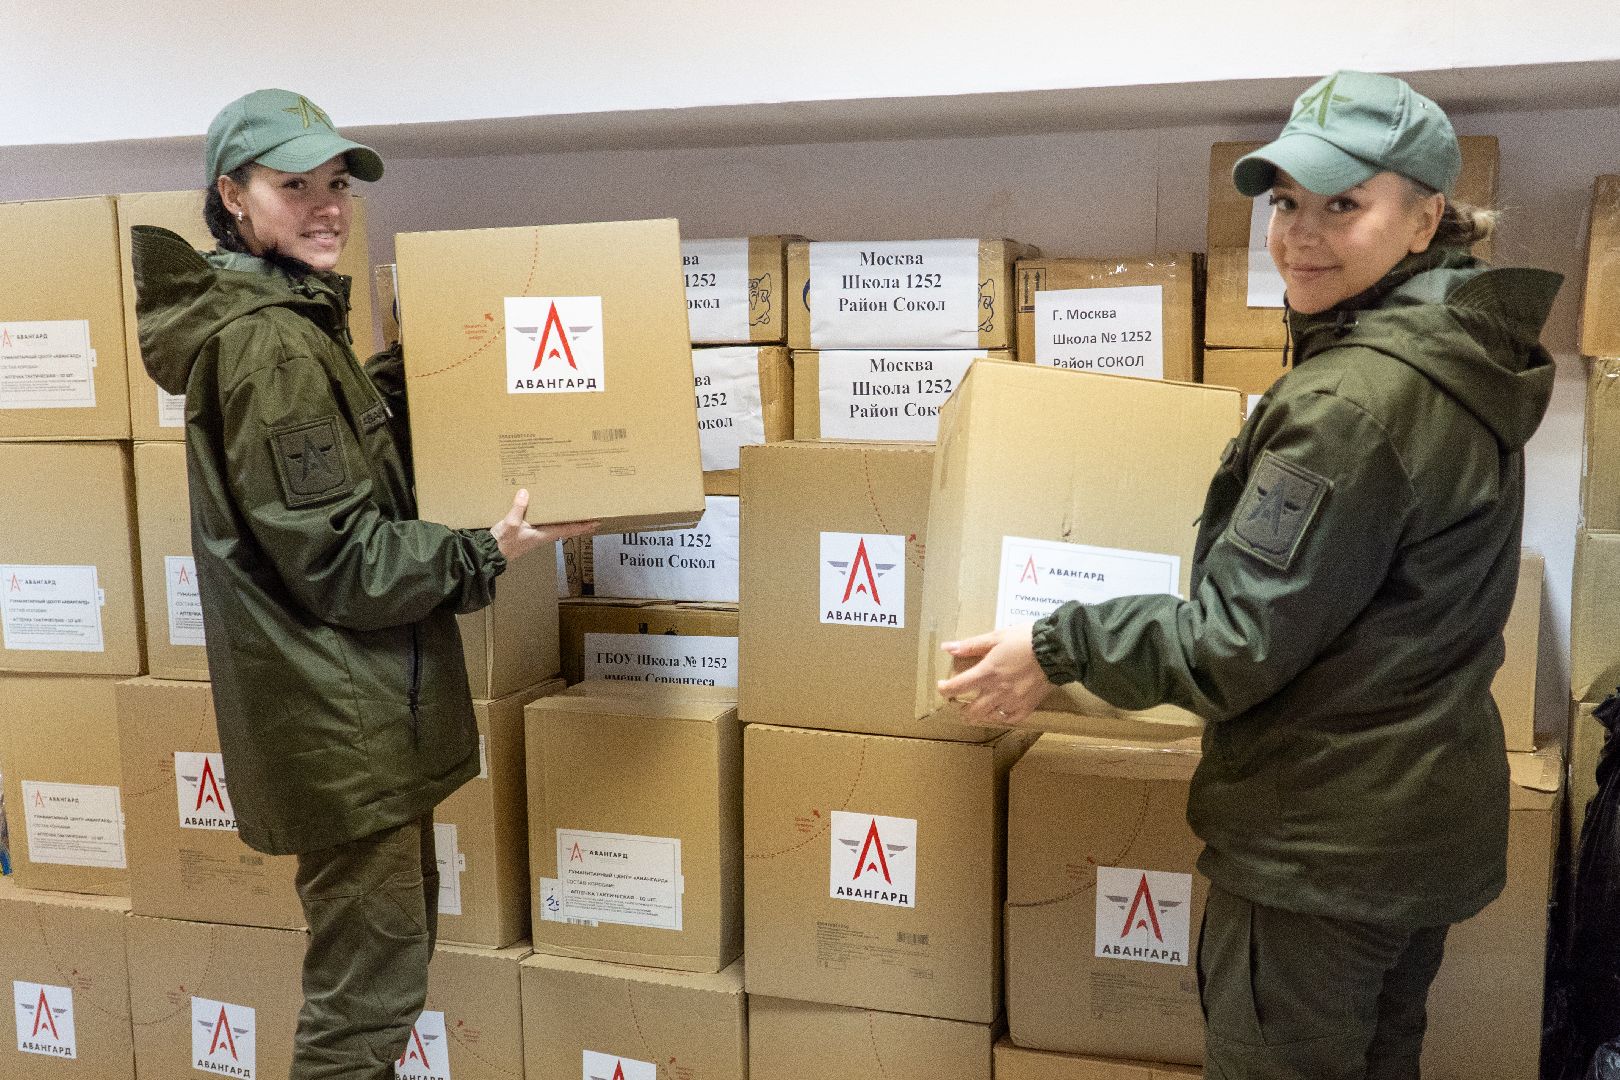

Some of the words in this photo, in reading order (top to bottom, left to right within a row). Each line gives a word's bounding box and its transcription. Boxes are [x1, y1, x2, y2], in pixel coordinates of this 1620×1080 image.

[860, 251, 923, 266] Москва
[685, 273, 716, 287] 1252
[841, 274, 900, 289] Школа
[906, 273, 942, 288] 1252
[687, 298, 720, 309] окол
[839, 296, 887, 312] Район
[893, 296, 946, 311] Сокол
[1052, 309, 1062, 320] Г.
[1066, 309, 1117, 320] Москва
[1053, 333, 1097, 345] Школа
[1101, 332, 1117, 343] №
[1121, 330, 1152, 342] 1252
[869, 357, 933, 373] Москва
[1053, 357, 1093, 368] Район
[1097, 355, 1144, 368] СОКОЛ
[515, 378, 597, 390] АВАНГАРД
[852, 380, 910, 396] Школа
[917, 378, 952, 394] 1252
[696, 392, 727, 409] 1252
[849, 402, 898, 419] Район
[904, 402, 940, 417] Сок
[698, 417, 733, 431] окол
[622, 533, 674, 547] Школа
[679, 533, 712, 548] 1252
[619, 552, 663, 568] Район
[668, 554, 715, 569] Сокол
[1049, 567, 1105, 582] АВАНГАРД
[1015, 594, 1066, 605] ГУМАНИТАР
[826, 610, 898, 625] АВАНГАРД
[597, 652, 634, 665] ГБОУ
[637, 654, 680, 667] Школа
[683, 655, 697, 668] №
[701, 656, 728, 669] 1252
[184, 817, 238, 829] АВАНГАРД
[589, 850, 628, 859] АВАНГАРД
[836, 886, 909, 905] АВАНГАРД
[1102, 943, 1182, 963] АВАНГАРД
[22, 1041, 72, 1057] АВАНГАРД
[197, 1059, 251, 1079] АВАНГАРД
